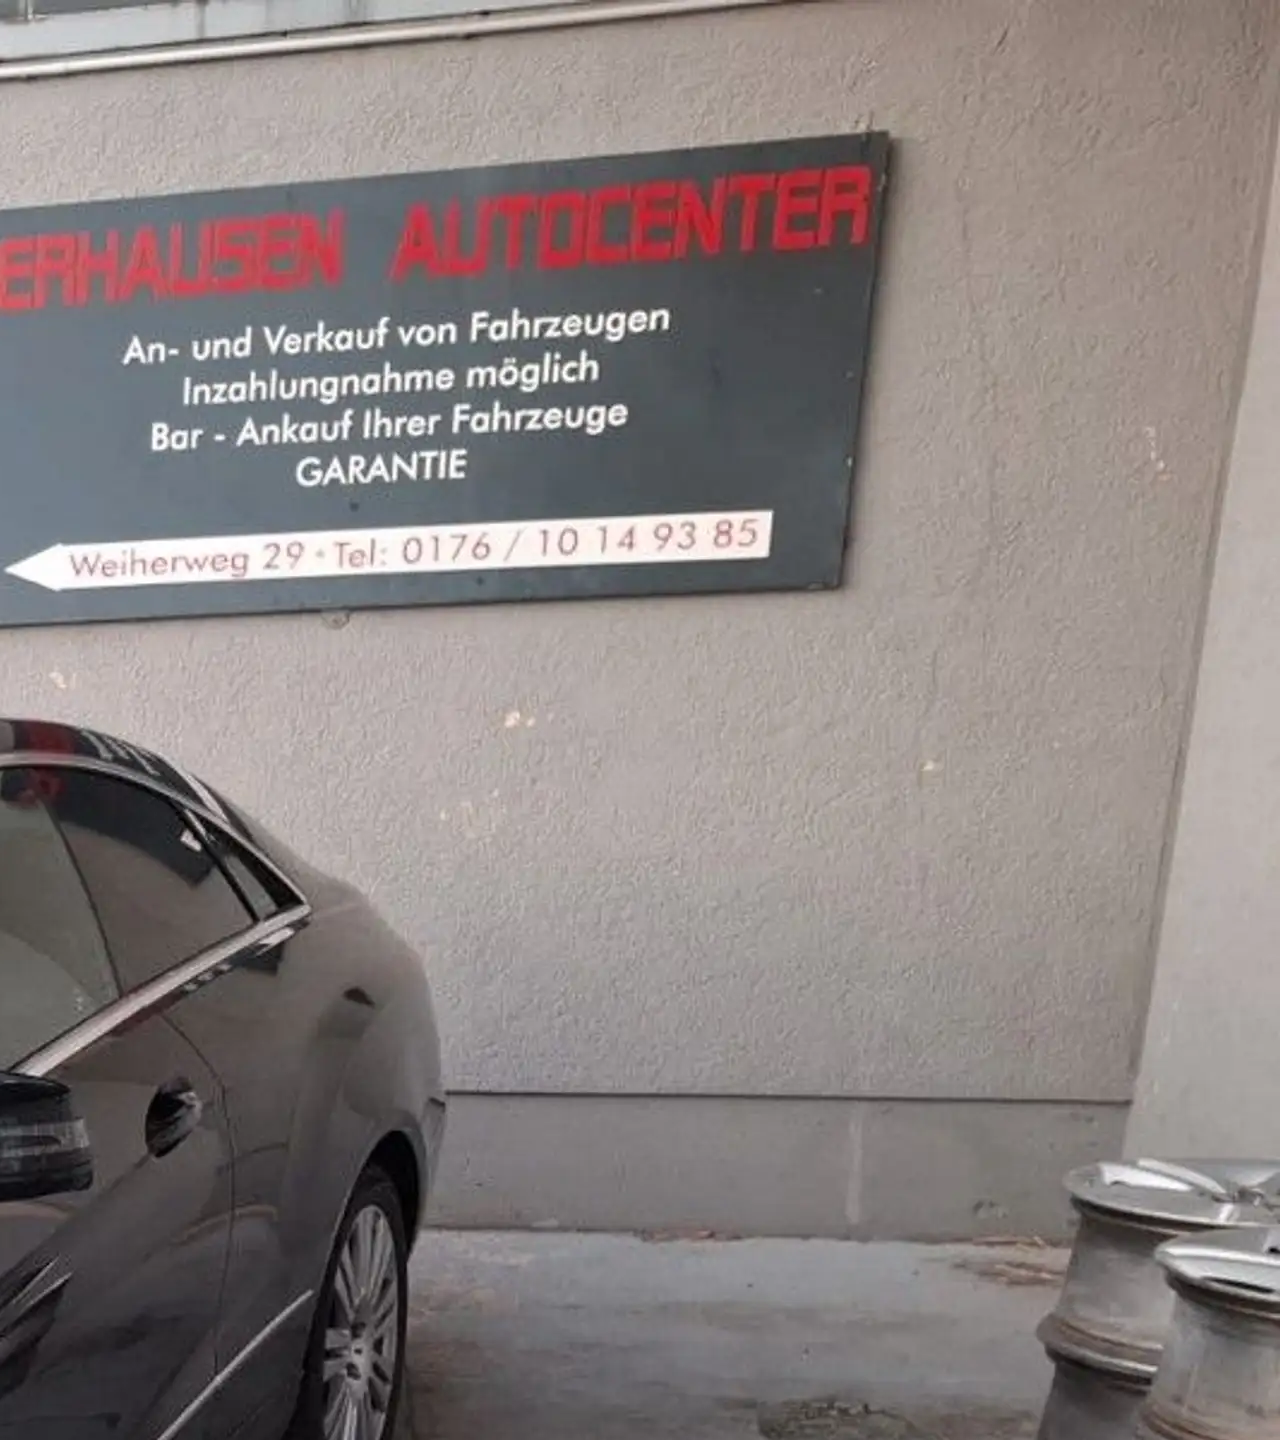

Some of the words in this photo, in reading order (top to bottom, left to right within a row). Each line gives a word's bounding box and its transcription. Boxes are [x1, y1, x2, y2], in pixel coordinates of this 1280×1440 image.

[389, 165, 872, 284] AUTOCENTER
[122, 335, 180, 366] An-
[192, 326, 252, 361] und
[262, 316, 391, 356] Verkauf
[397, 322, 457, 348] von
[470, 307, 671, 343] Fahrzeugen
[183, 361, 455, 405] Inzahlungnahme
[466, 349, 600, 393] möglich
[150, 422, 203, 452] Bar
[236, 408, 354, 447] Ankauf
[363, 407, 441, 440] Ihrer
[451, 400, 629, 436] Fahrzeuge
[295, 448, 468, 488] GARANTIE
[68, 548, 251, 578] Weiherweg
[263, 540, 306, 570] 29
[333, 537, 388, 569] Tel:
[402, 532, 492, 566] 0176
[503, 527, 527, 562] /
[539, 527, 579, 557] 10
[597, 524, 637, 554] 14
[653, 521, 697, 551] 93
[706, 518, 760, 549] 85
